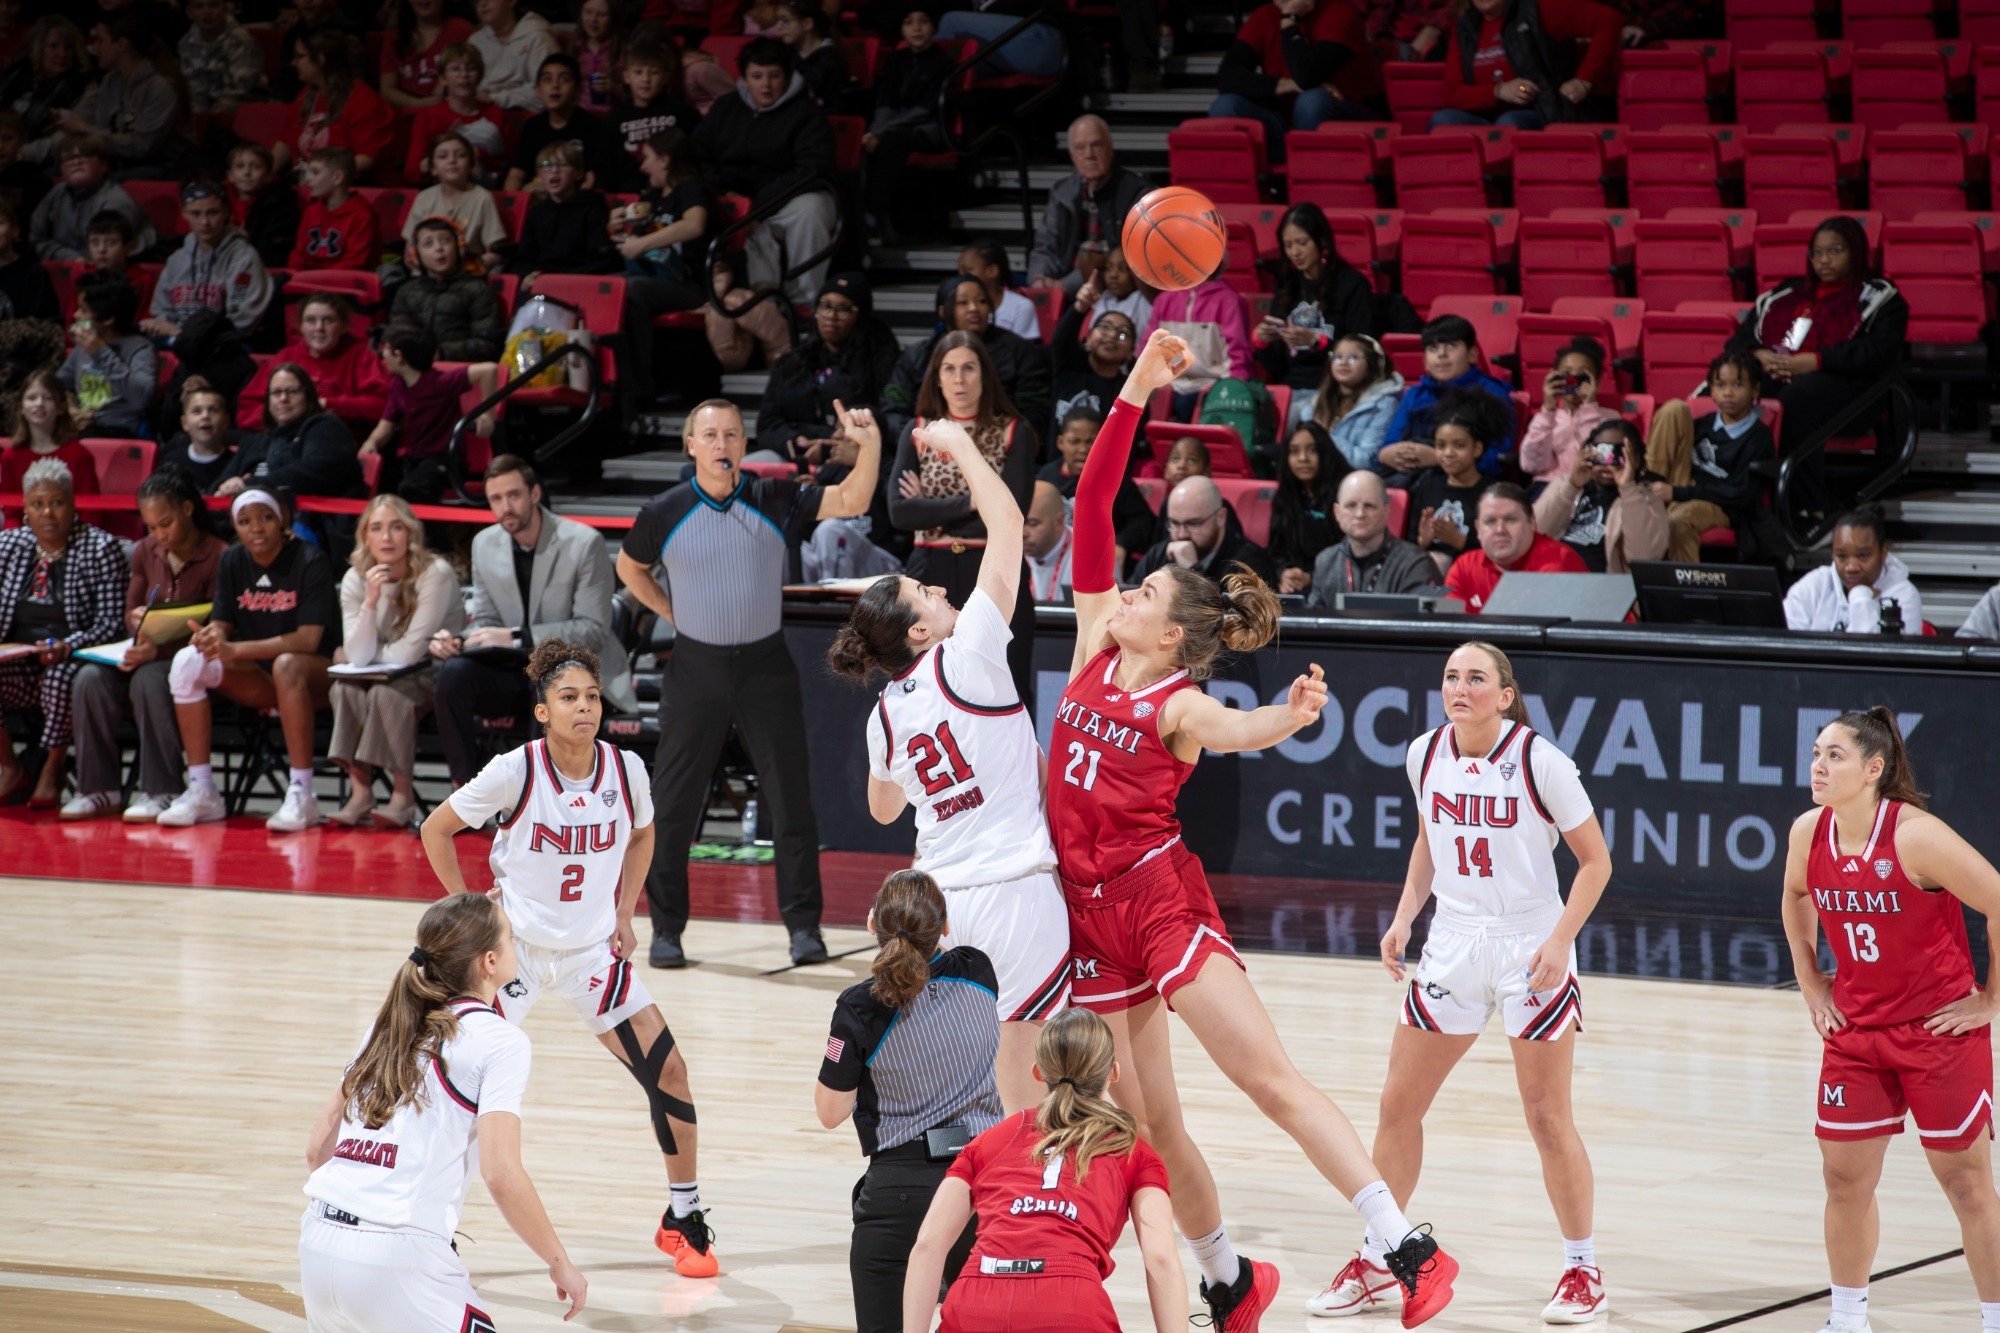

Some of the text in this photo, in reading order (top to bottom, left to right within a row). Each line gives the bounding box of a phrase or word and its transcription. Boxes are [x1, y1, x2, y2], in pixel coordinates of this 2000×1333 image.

[620, 115, 677, 133] CHICAGO
[1162, 262, 1193, 287] NIU
[607, 720, 642, 735] NIU
[1056, 696, 1146, 755] MIAMI
[907, 719, 976, 797] 21
[1064, 740, 1103, 792] 21
[1431, 792, 1519, 828] NIU
[529, 820, 618, 854] NIU
[1455, 836, 1494, 878] 14
[559, 864, 586, 902] 2
[1813, 886, 1904, 914] MIAMI
[1843, 922, 1880, 963] 13
[1073, 956, 1102, 980] M
[1821, 1082, 1848, 1108] M
[1009, 1196, 1079, 1221] SCALIA
